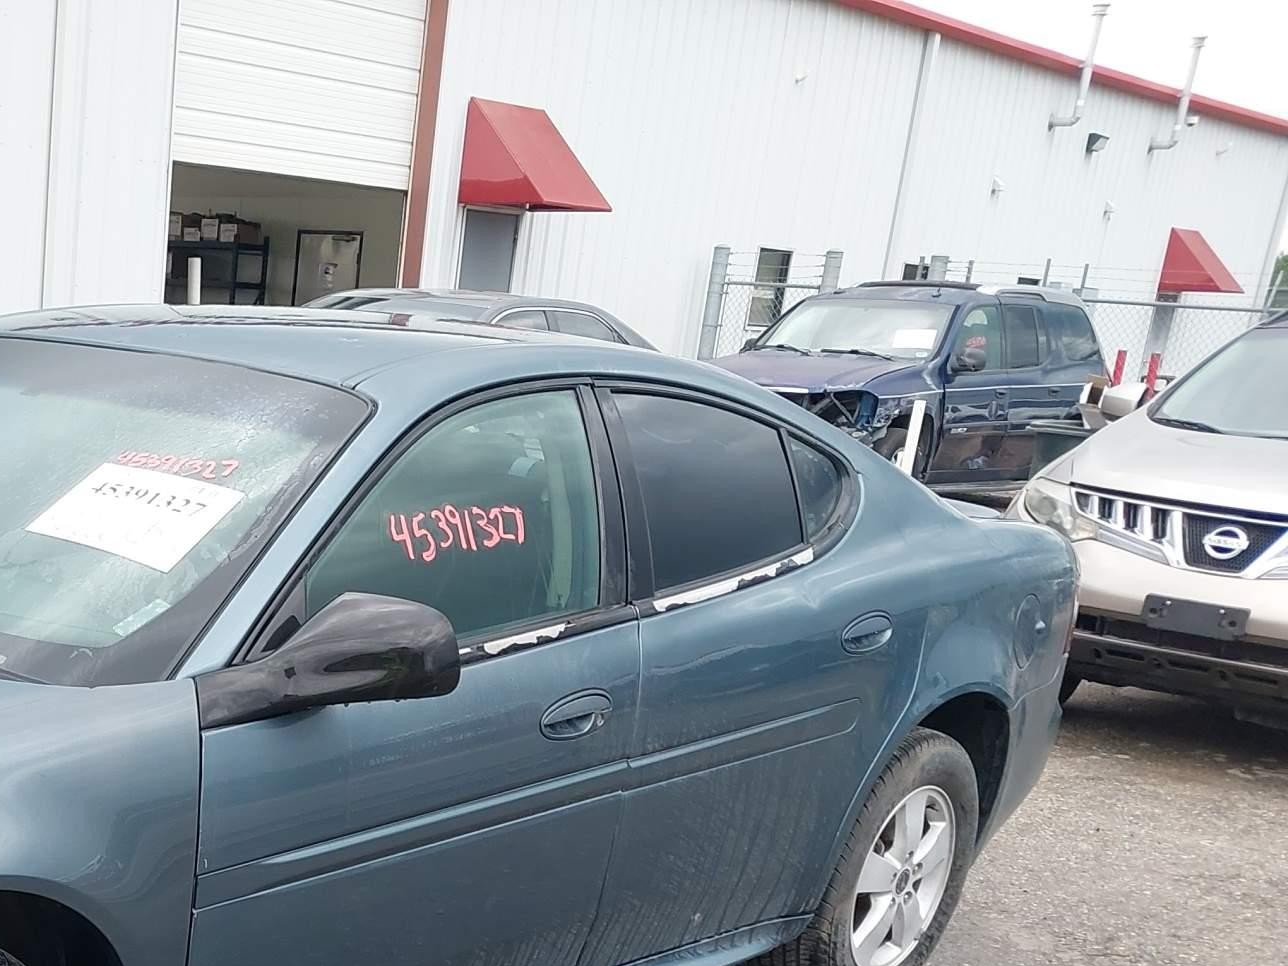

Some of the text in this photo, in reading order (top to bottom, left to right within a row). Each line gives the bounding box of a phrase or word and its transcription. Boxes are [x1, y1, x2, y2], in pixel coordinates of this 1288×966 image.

[118, 450, 239, 479] 45391327
[91, 481, 207, 517] 45391327
[389, 504, 525, 562] 45391327
